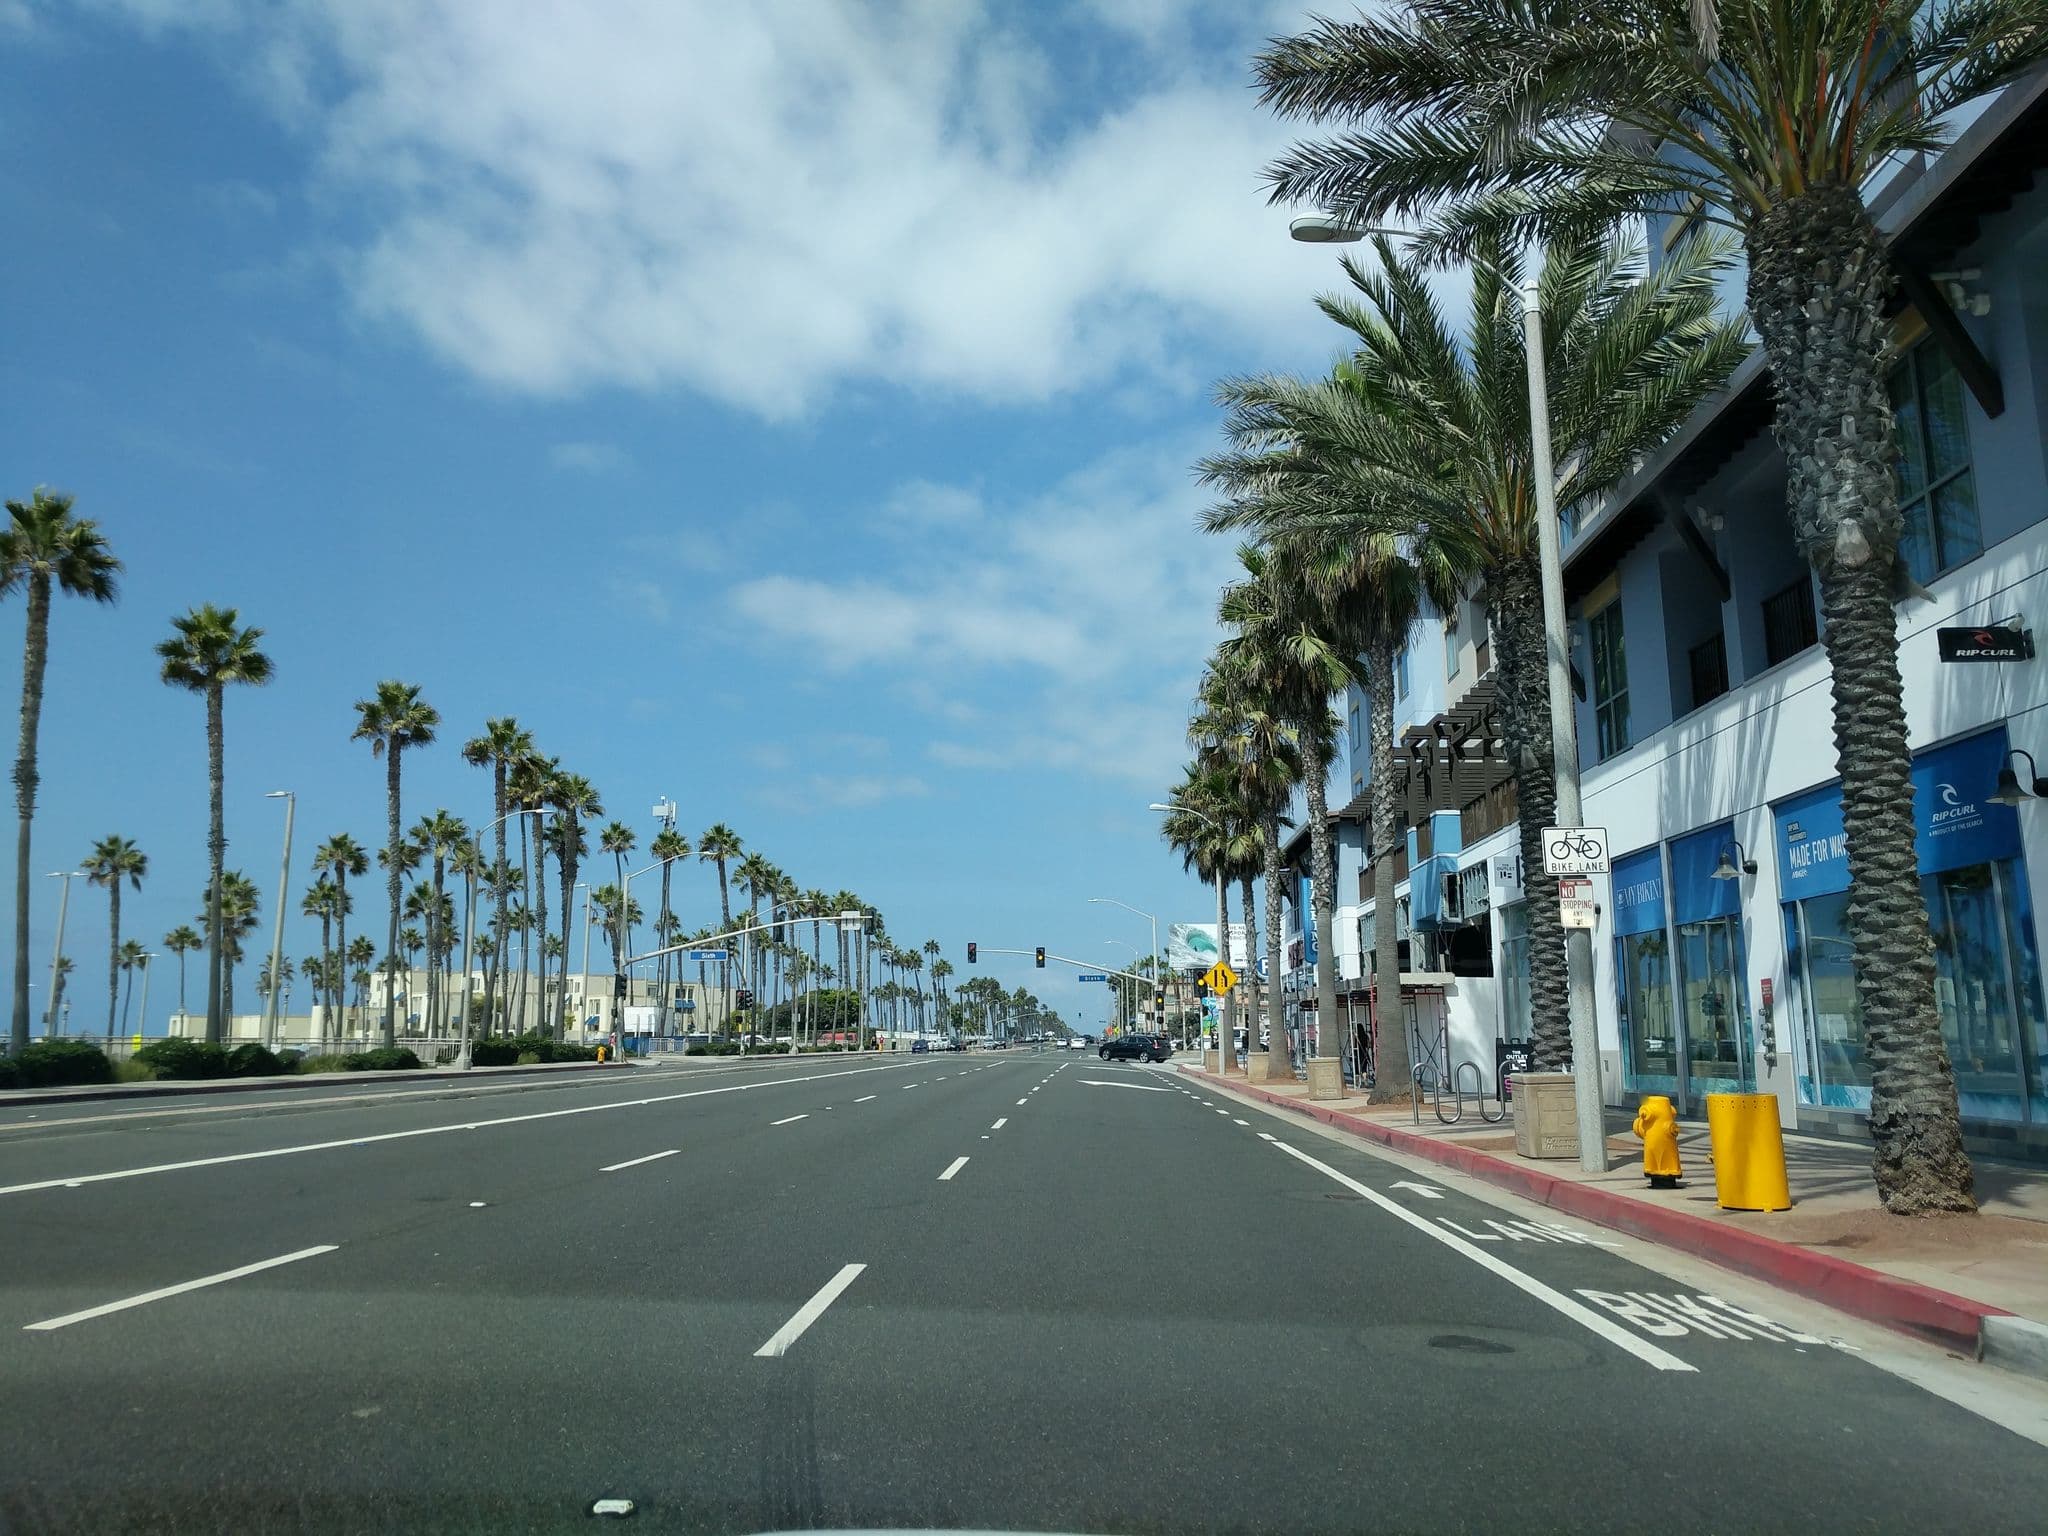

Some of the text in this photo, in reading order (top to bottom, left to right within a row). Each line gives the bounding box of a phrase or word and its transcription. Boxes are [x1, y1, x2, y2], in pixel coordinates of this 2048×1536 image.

[1932, 804, 1976, 822] RIP CURL
[1789, 843, 1811, 870] MADE
[1812, 839, 1829, 864] FOR
[1829, 832, 1849, 859] WAV
[1551, 862, 1604, 872] BIKE LANE
[1562, 886, 1574, 898] NO
[1563, 899, 1593, 909] STOPPING
[1573, 1289, 1858, 1350] BIKE
